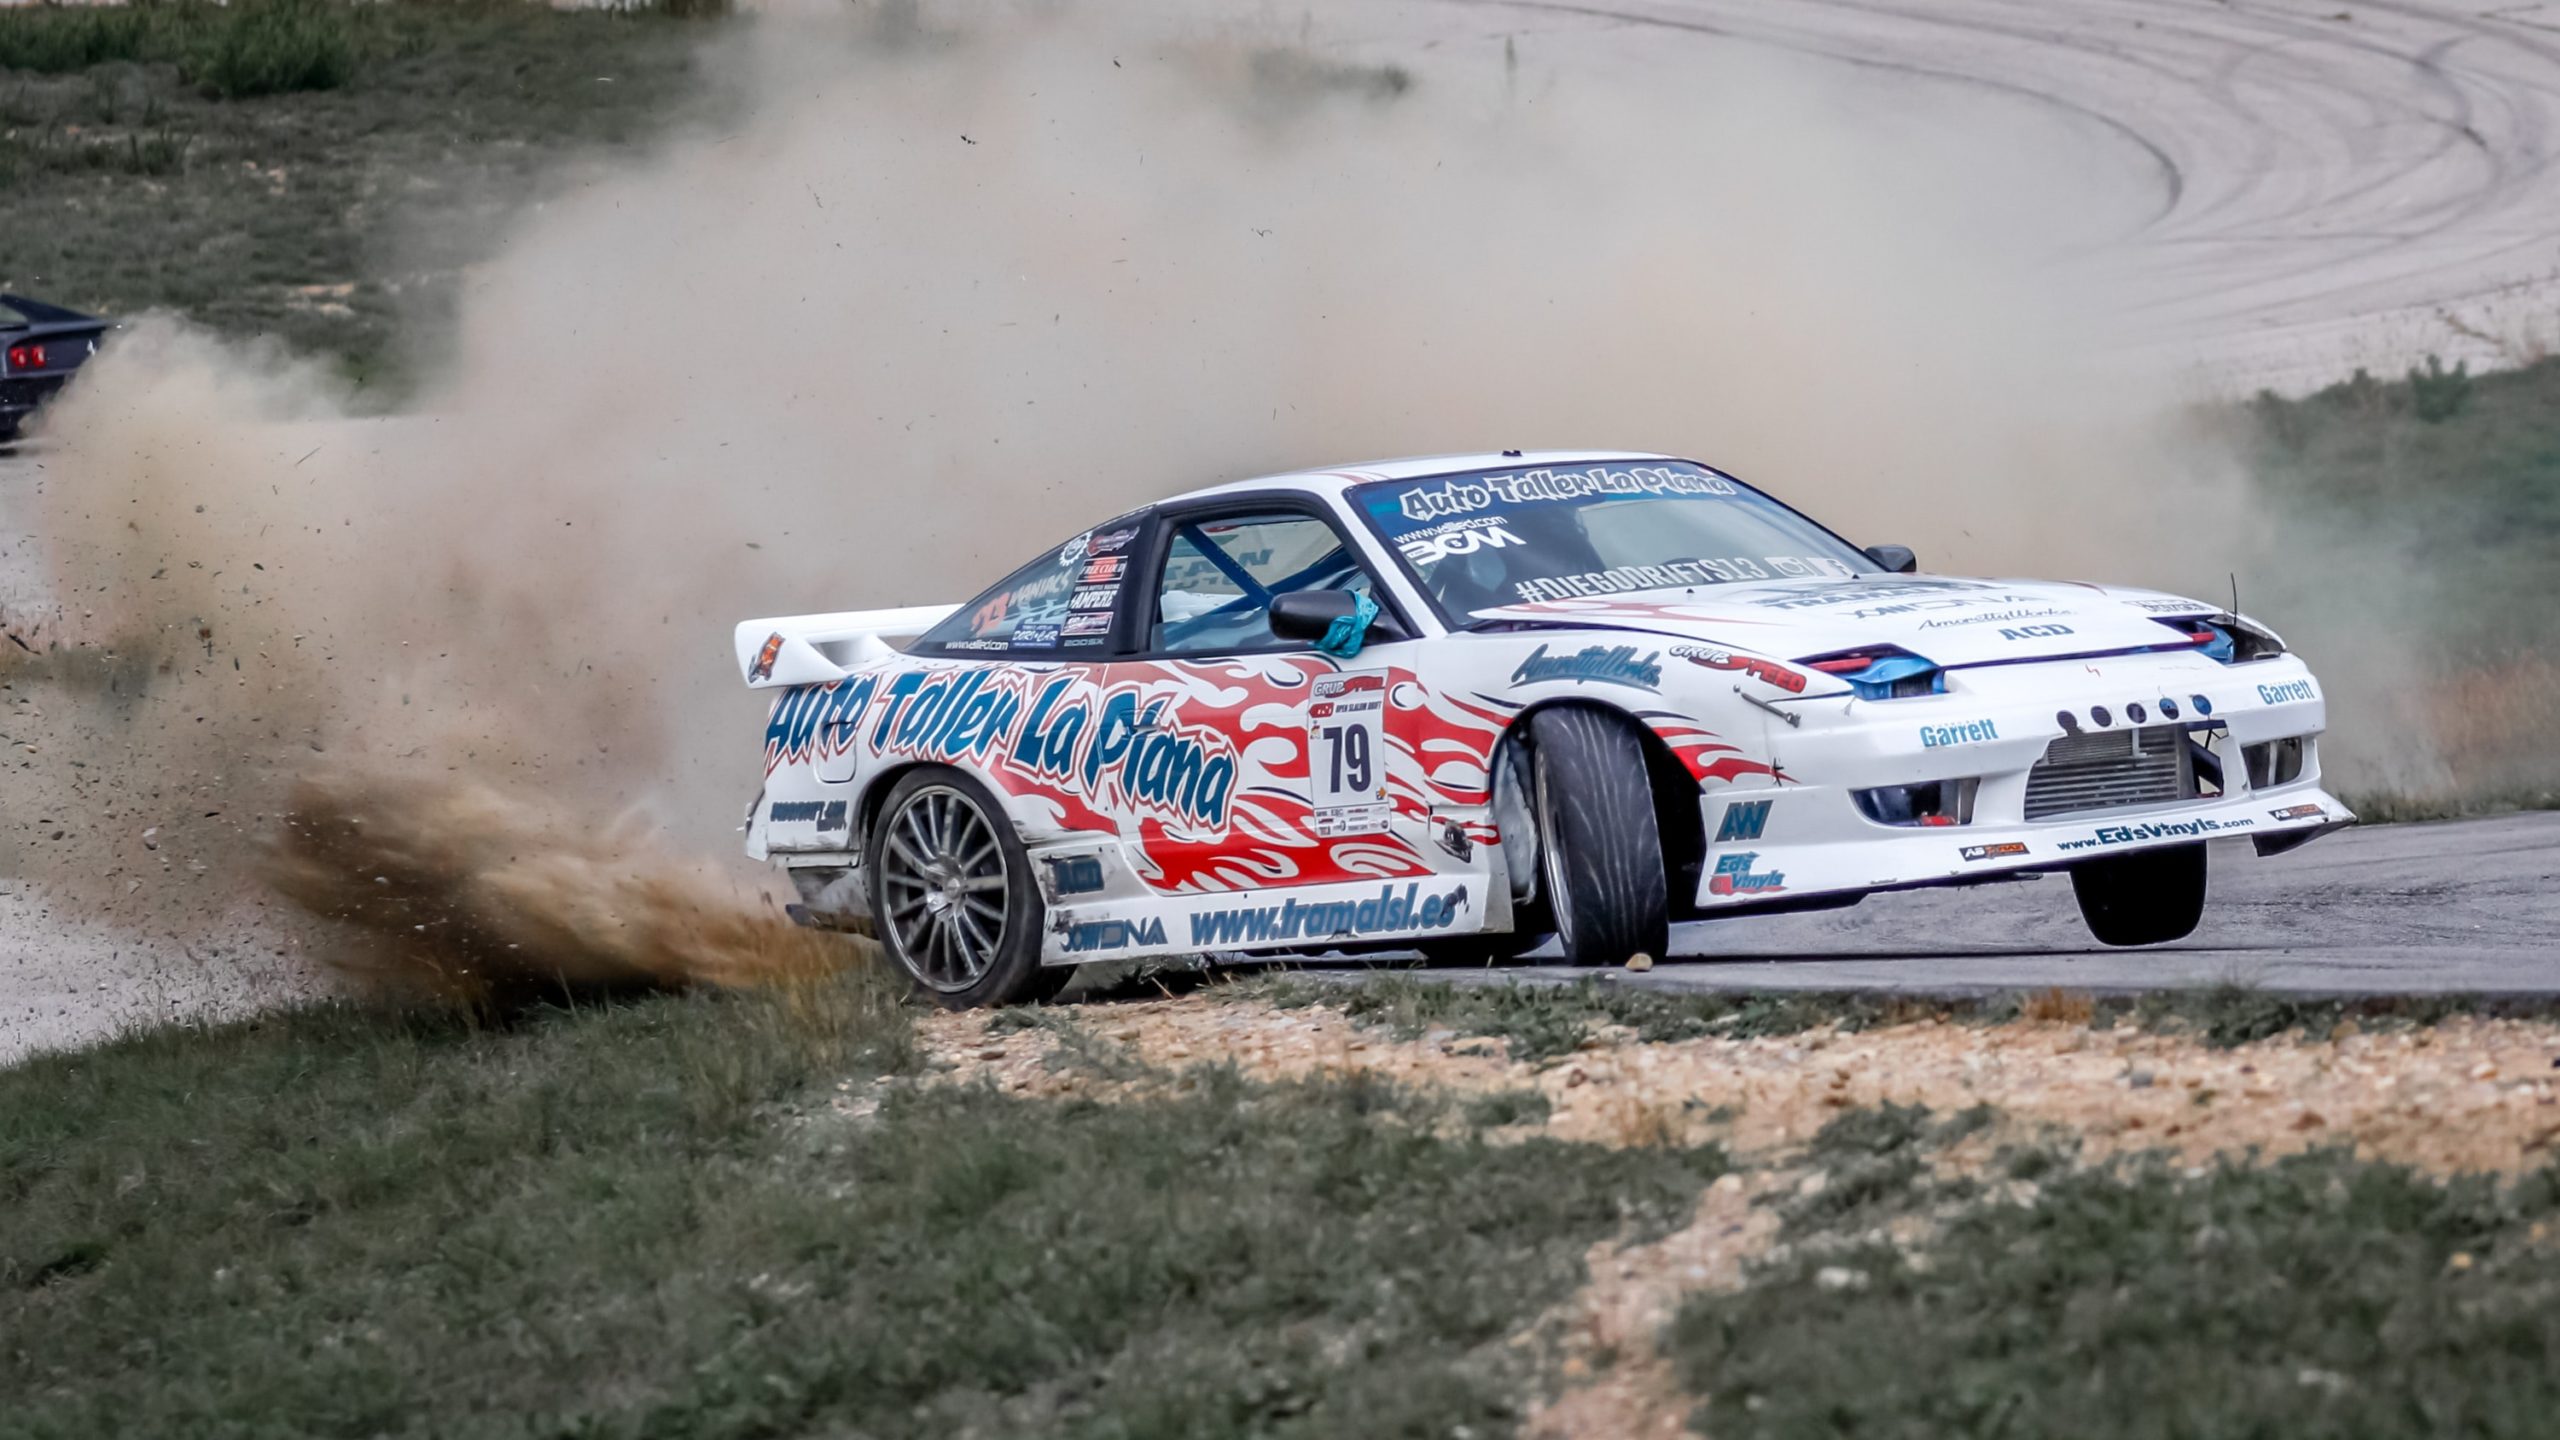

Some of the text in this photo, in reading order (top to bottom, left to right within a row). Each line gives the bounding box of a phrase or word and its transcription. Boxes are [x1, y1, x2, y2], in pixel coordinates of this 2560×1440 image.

[1399, 468, 1737, 521] Auto Taller La Plana
[1669, 644, 1733, 665] GRUP
[1314, 681, 1346, 697] GRUP
[2257, 679, 2315, 705] Garrett
[766, 668, 1236, 829] Auto Taller La Plana
[1920, 719, 1999, 747] Garrett
[1323, 724, 1371, 793] 79
[1190, 883, 1456, 946] www.tramalsl.es
